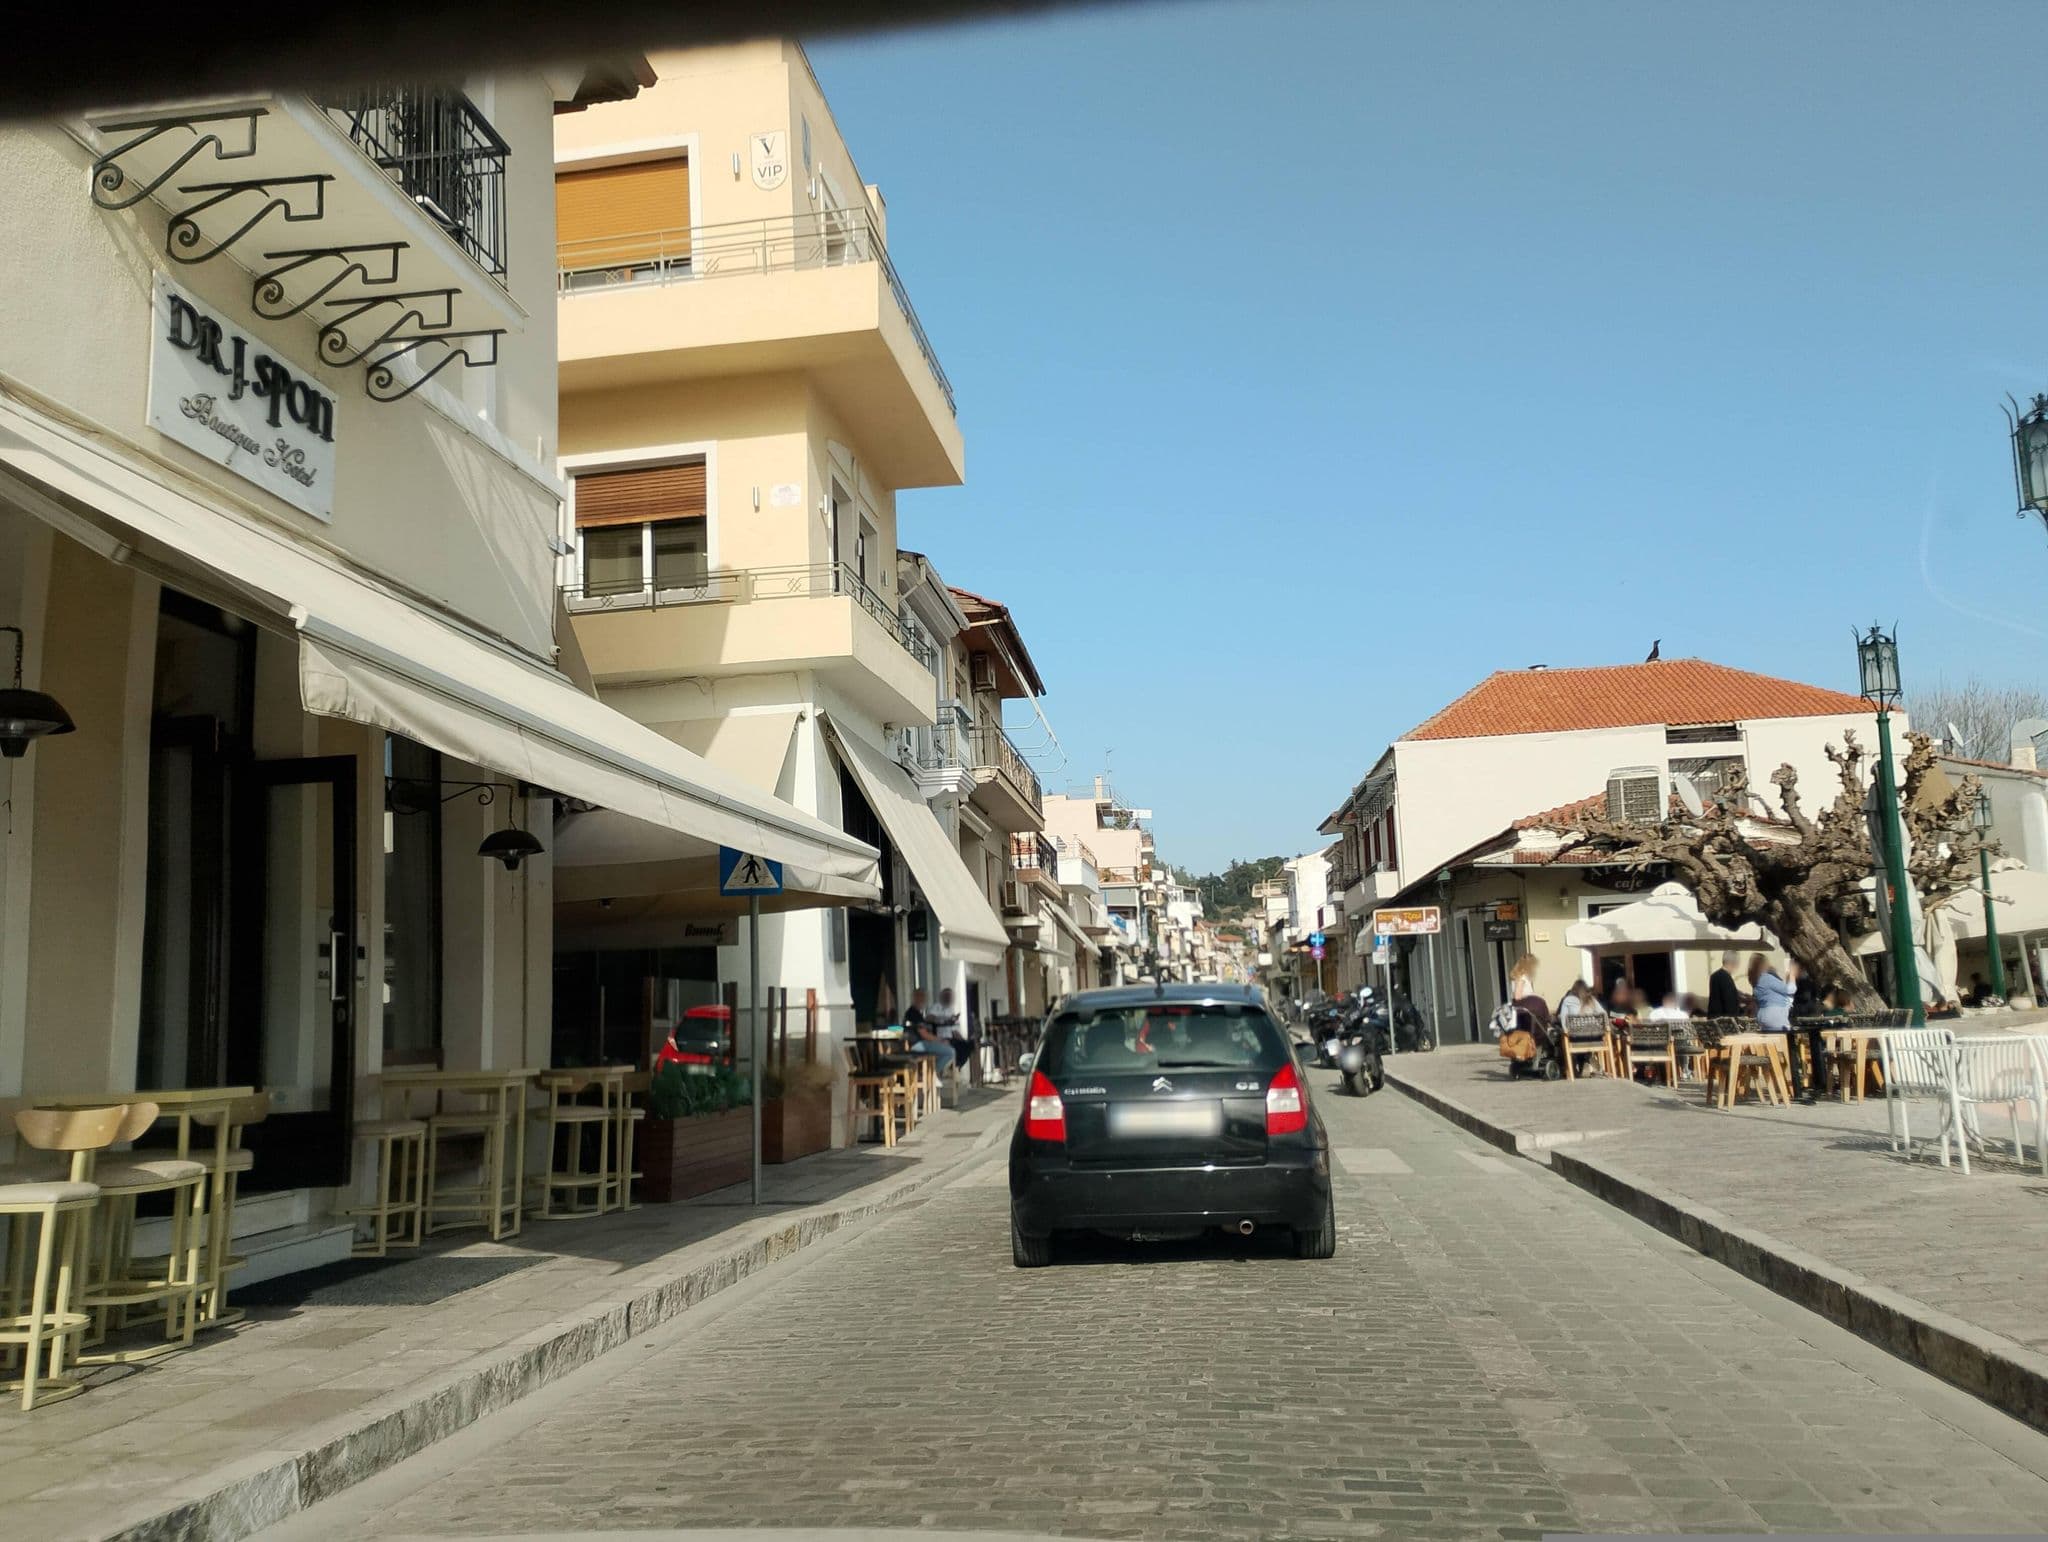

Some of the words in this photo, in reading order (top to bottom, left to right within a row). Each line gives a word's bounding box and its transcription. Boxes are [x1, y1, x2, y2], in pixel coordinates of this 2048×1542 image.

[757, 164, 783, 178] VIP
[178, 393, 261, 465] Boutique
[263, 438, 318, 488] Hotel
